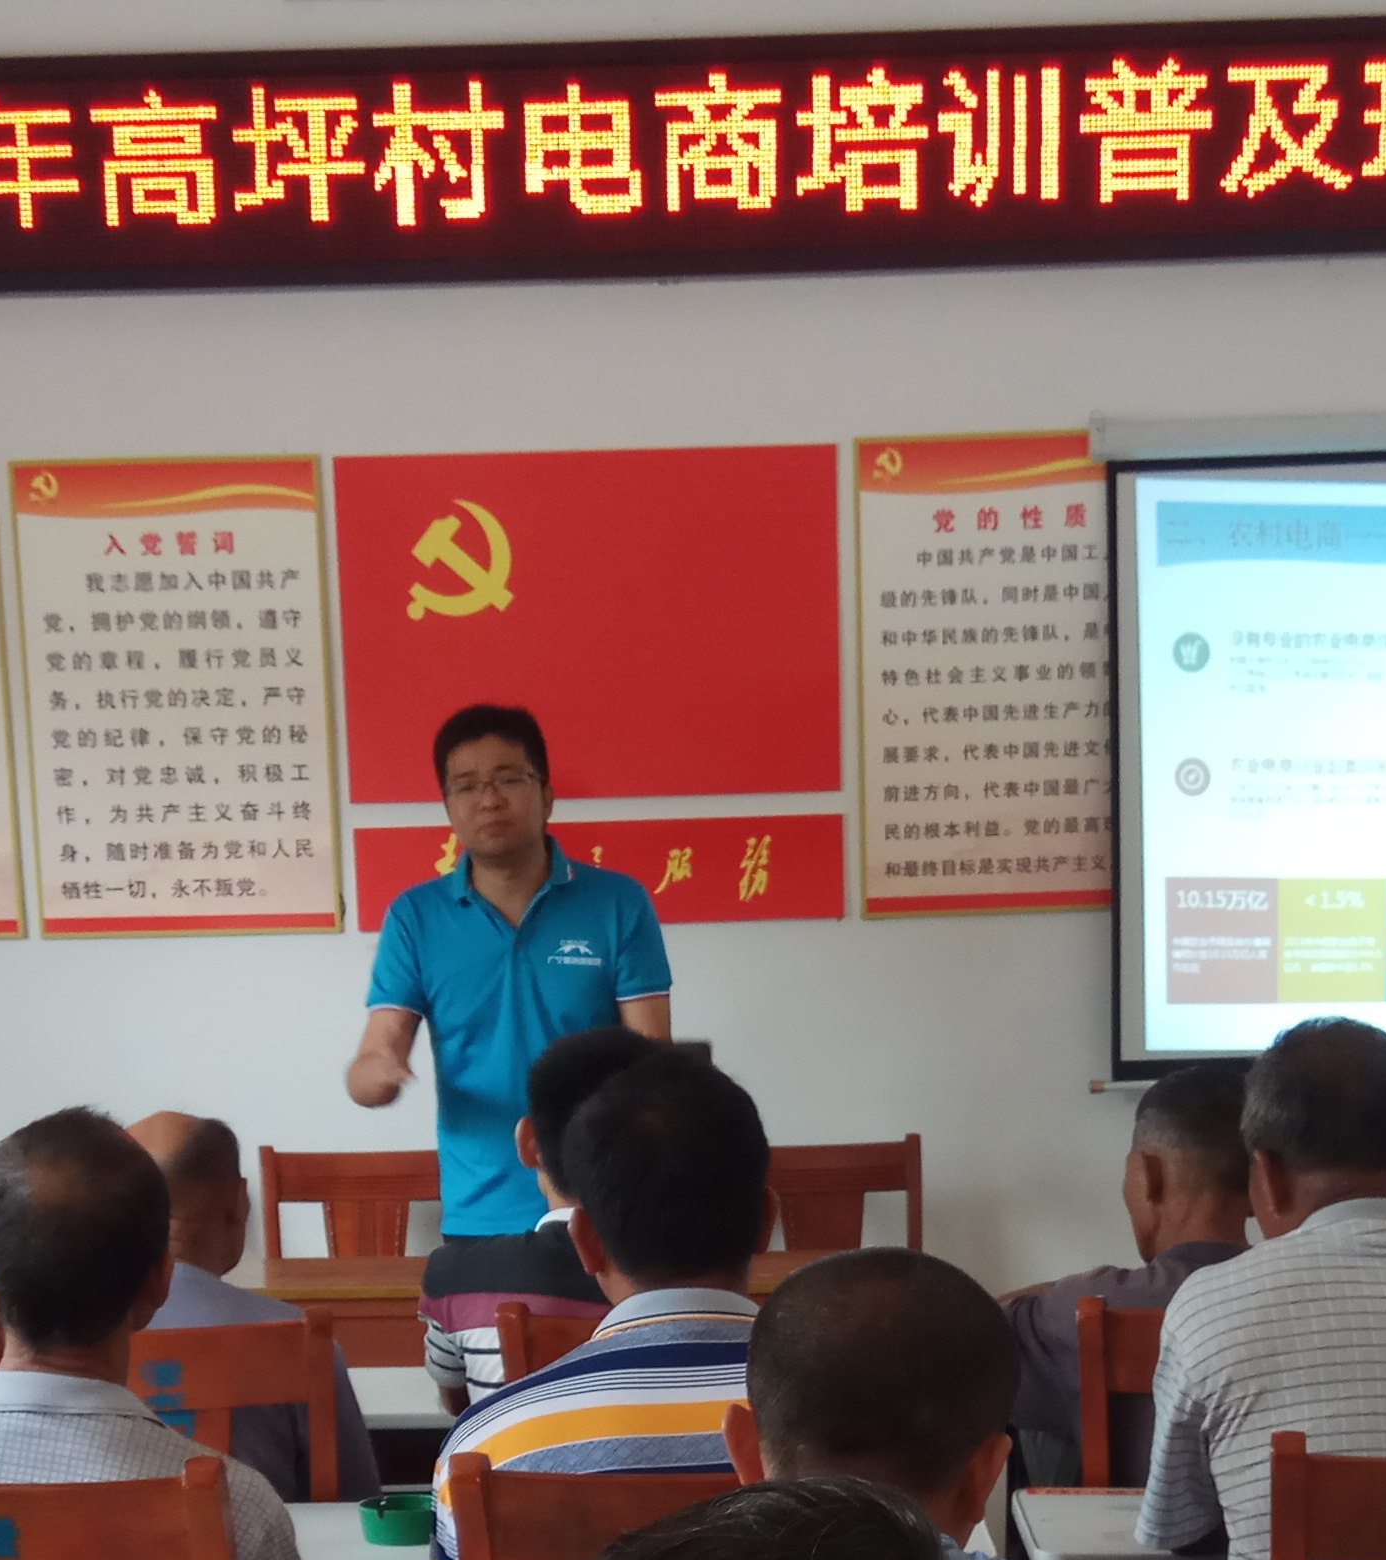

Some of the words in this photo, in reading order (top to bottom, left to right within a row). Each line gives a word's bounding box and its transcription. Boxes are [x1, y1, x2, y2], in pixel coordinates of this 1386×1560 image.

[932, 502, 1088, 533] 党的性质
[103, 530, 236, 556] 入党誓词
[916, 543, 1109, 567] 中国共产党是中国工
[85, 569, 301, 593] 我志愿加入中国共产
[879, 583, 1109, 609] 级的先锋队，同时是中国
[51, 724, 309, 748] 党的纪律，保守党的秘
[53, 762, 310, 787] 密，对党忠诚，积极工
[56, 800, 313, 825] 作，为共产主义奋斗终
[59, 839, 315, 863] 身，随时准备为党和人民
[61, 877, 271, 900] 牺牲一切，永不叛党。
[1176, 889, 1270, 912] 10.15万亿
